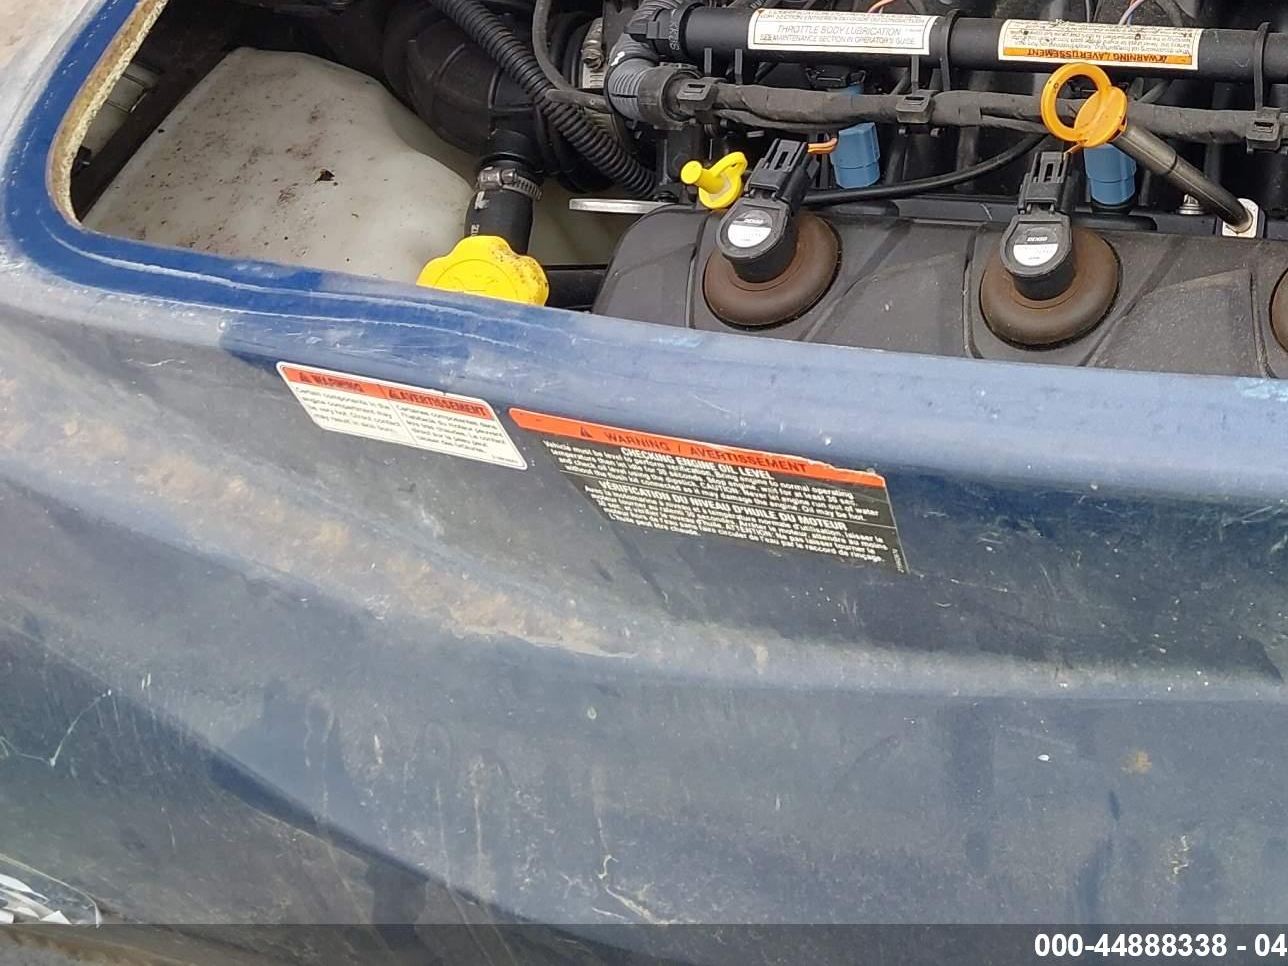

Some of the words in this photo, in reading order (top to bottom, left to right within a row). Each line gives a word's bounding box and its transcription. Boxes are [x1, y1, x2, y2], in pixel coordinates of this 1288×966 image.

[772, 34, 817, 42] MAINTENANCE
[778, 24, 820, 34] THROTTLE
[820, 26, 846, 35] BODY
[846, 26, 900, 36] LUBRICATION
[1027, 48, 1104, 62] AVERTISSEMENT
[1113, 53, 1160, 64] WARNING
[400, 392, 486, 416] AVERTISSEMENT
[604, 432, 670, 451] WARNING
[690, 446, 807, 472] AVERTISSEMENT
[620, 447, 676, 464] CHECKING
[675, 456, 718, 471] ENGINE
[718, 463, 739, 474] OIL
[738, 467, 775, 480] LEVEL
[598, 479, 672, 502] VÉRIFICATION
[672, 494, 688, 504] DU
[689, 496, 732, 512] NIVEAU
[732, 504, 780, 520] D'HUILE
[778, 512, 797, 522] DU
[797, 516, 848, 531] MOTEUR
